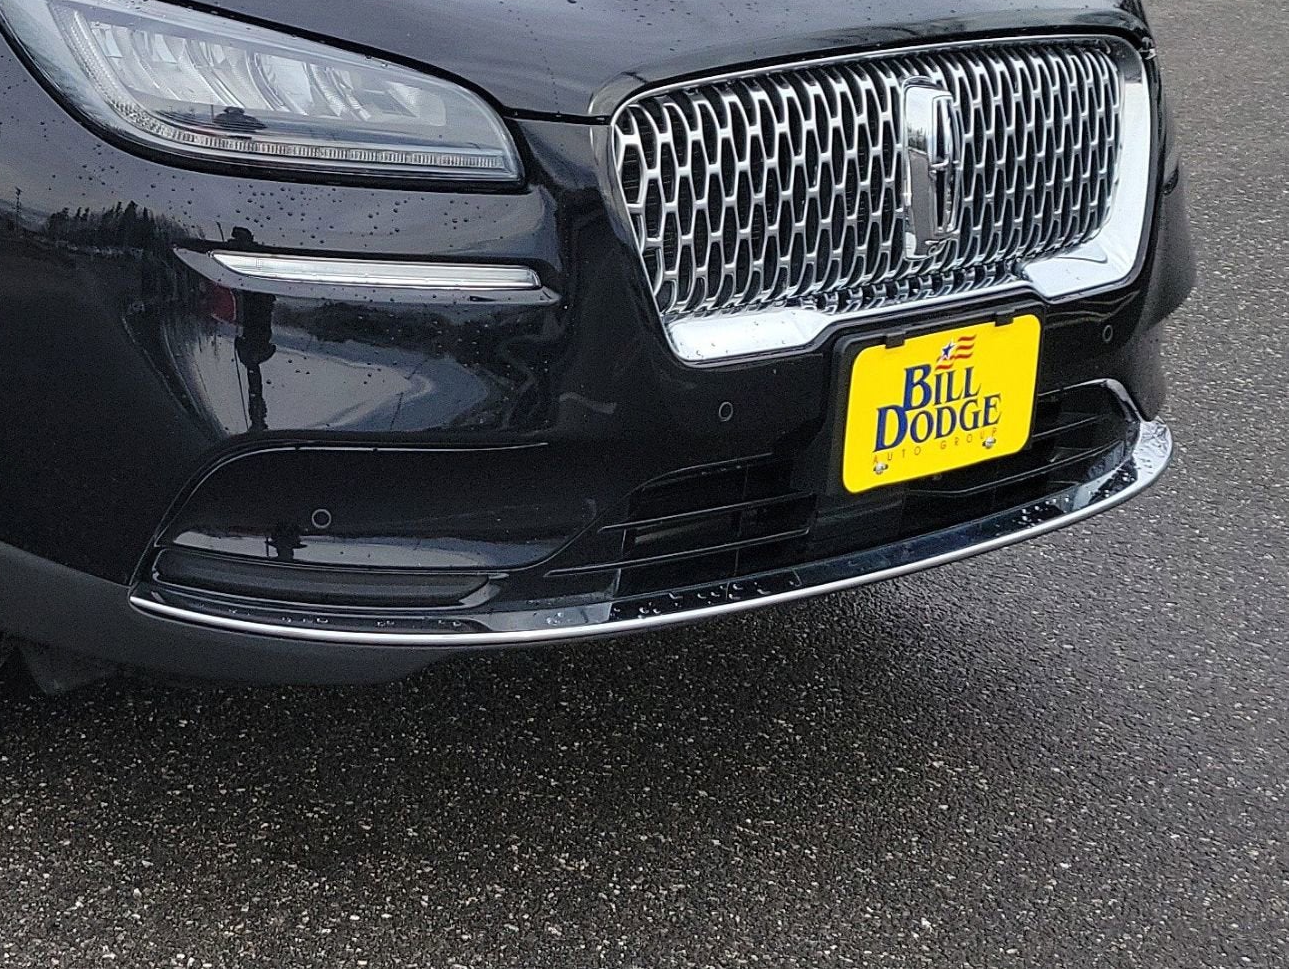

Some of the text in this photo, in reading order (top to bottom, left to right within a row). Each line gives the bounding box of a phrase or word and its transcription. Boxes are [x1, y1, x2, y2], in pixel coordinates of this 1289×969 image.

[902, 363, 982, 412] BILL
[872, 393, 1003, 453] DODGE
[872, 427, 998, 465] AUTO GROUP
